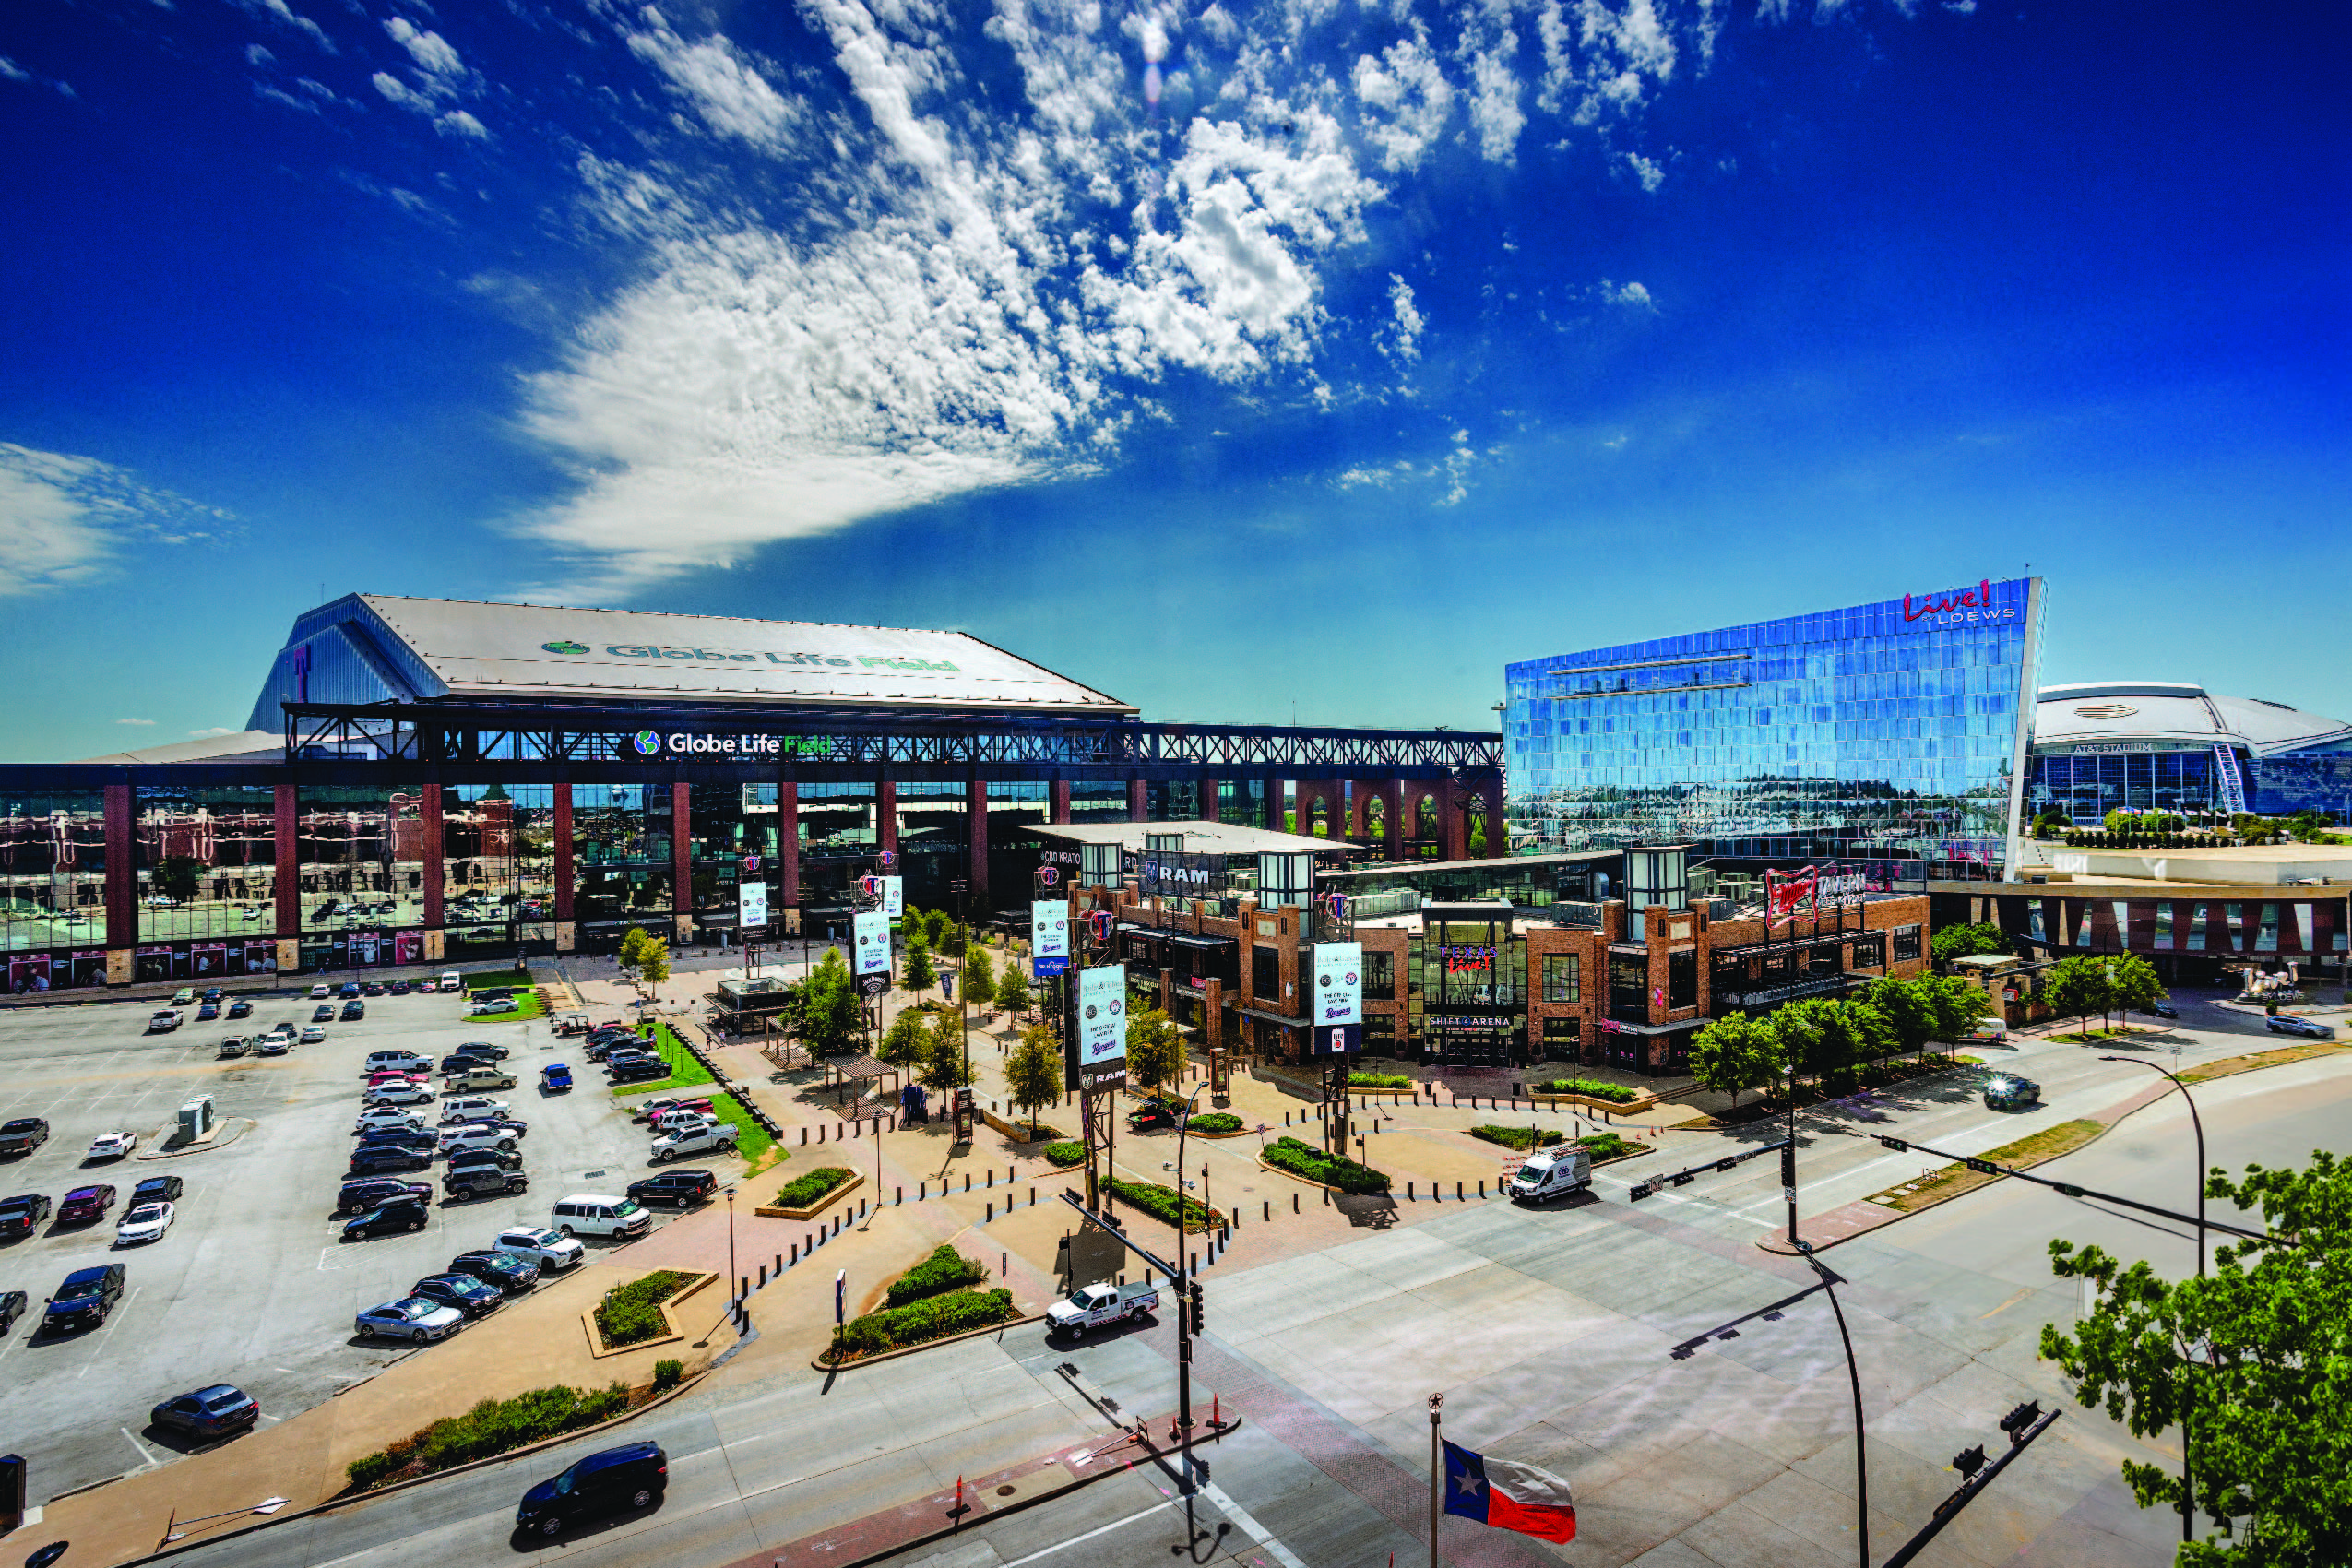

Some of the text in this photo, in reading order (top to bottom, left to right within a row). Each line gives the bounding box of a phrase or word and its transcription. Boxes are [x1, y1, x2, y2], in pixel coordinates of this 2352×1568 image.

[1904, 579, 1990, 621] Live!
[1938, 609, 2015, 624] LOEWS
[606, 646, 962, 672] Globe Life Field
[668, 733, 831, 753] Globe Life Field
[2074, 742, 2155, 753] AT&T STADIUM
[1044, 851, 1058, 861] CBD
[1160, 866, 1209, 884] RAM
[1439, 946, 1498, 958] TEXAS
[1448, 956, 1490, 974] Live!
[1472, 1017, 1510, 1026] ARENA
[1096, 1070, 1126, 1084] RAM
